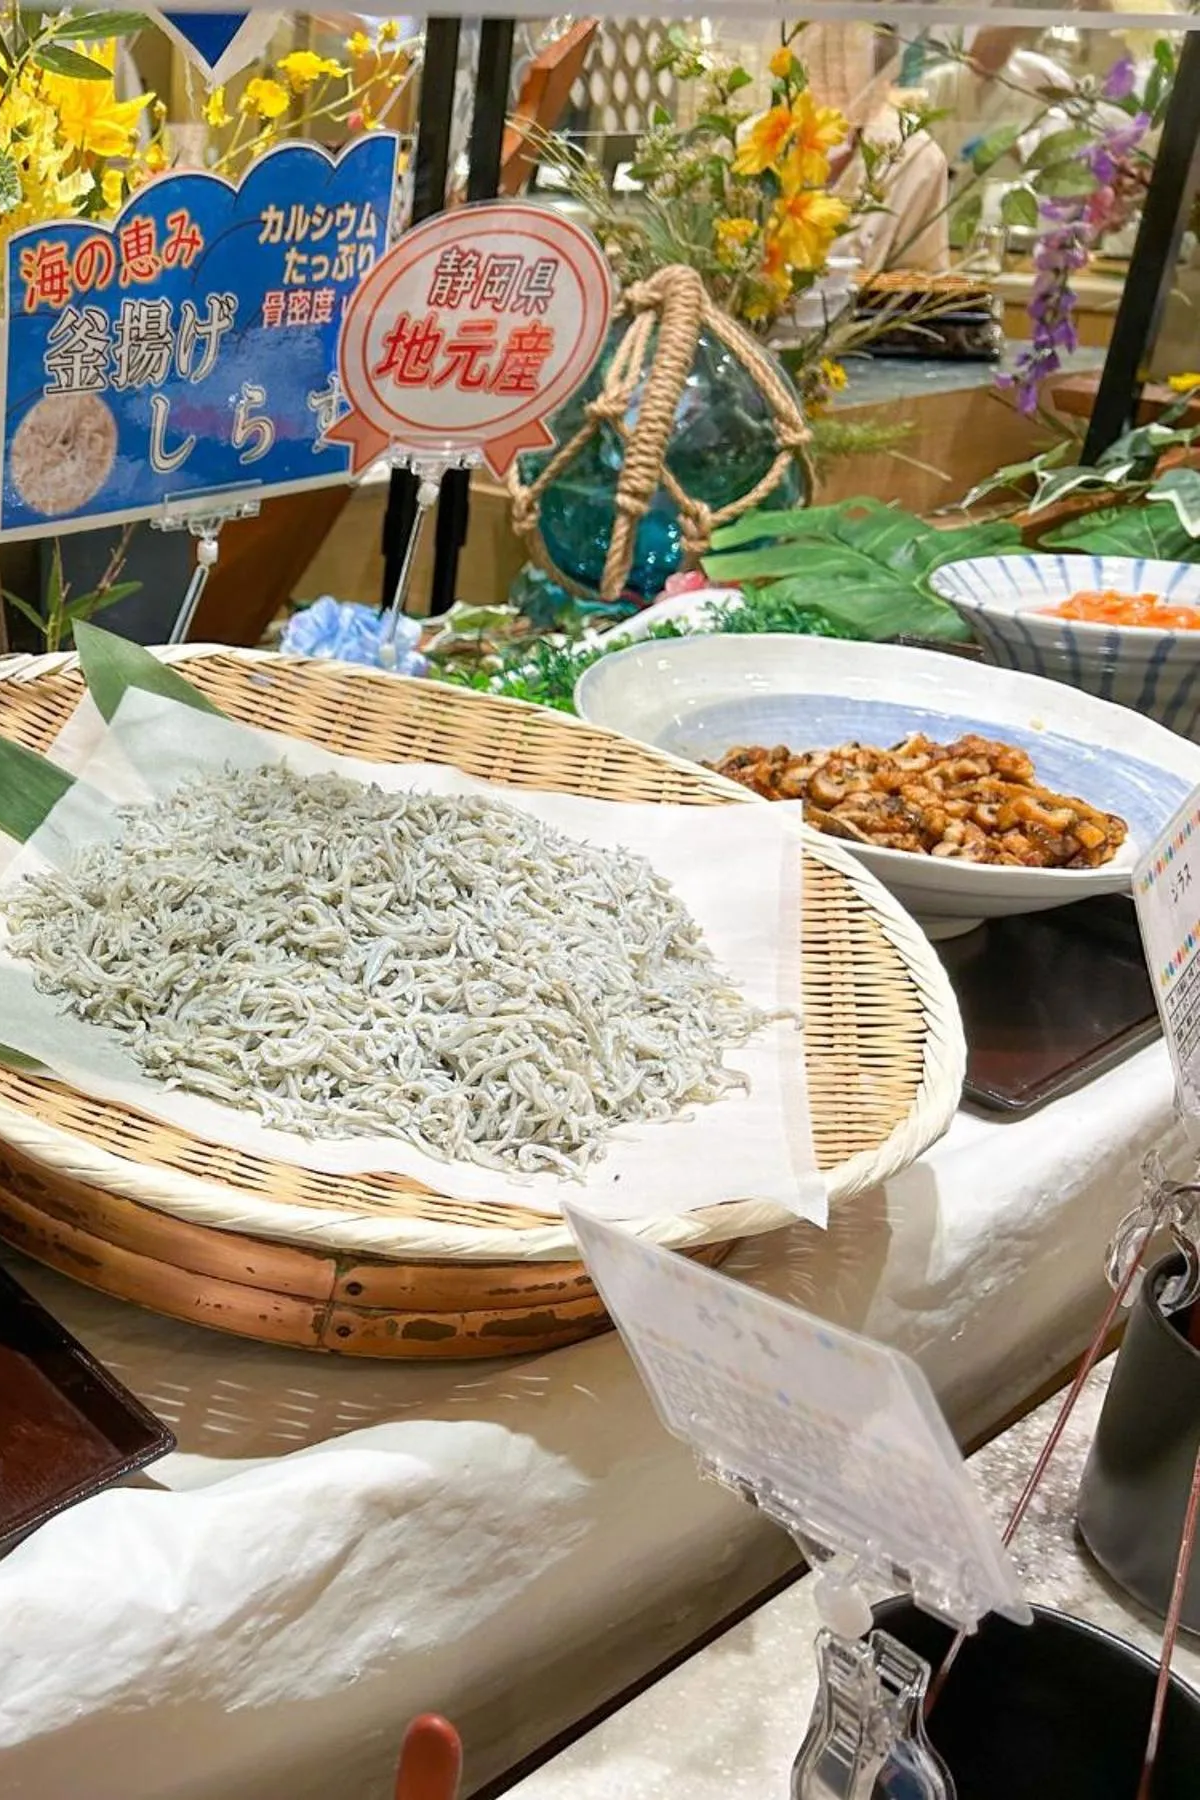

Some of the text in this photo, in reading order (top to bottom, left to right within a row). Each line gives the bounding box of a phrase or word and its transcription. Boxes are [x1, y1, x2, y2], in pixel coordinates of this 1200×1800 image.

[19, 209, 204, 310] 海の恵み
[258, 201, 377, 245] カルシウム
[282, 243, 375, 285] たっぷり
[427, 244, 559, 318] 静岡県
[43, 291, 240, 396] 釜揚げ
[262, 287, 352, 328] 骨密度
[373, 310, 556, 396] 地元産
